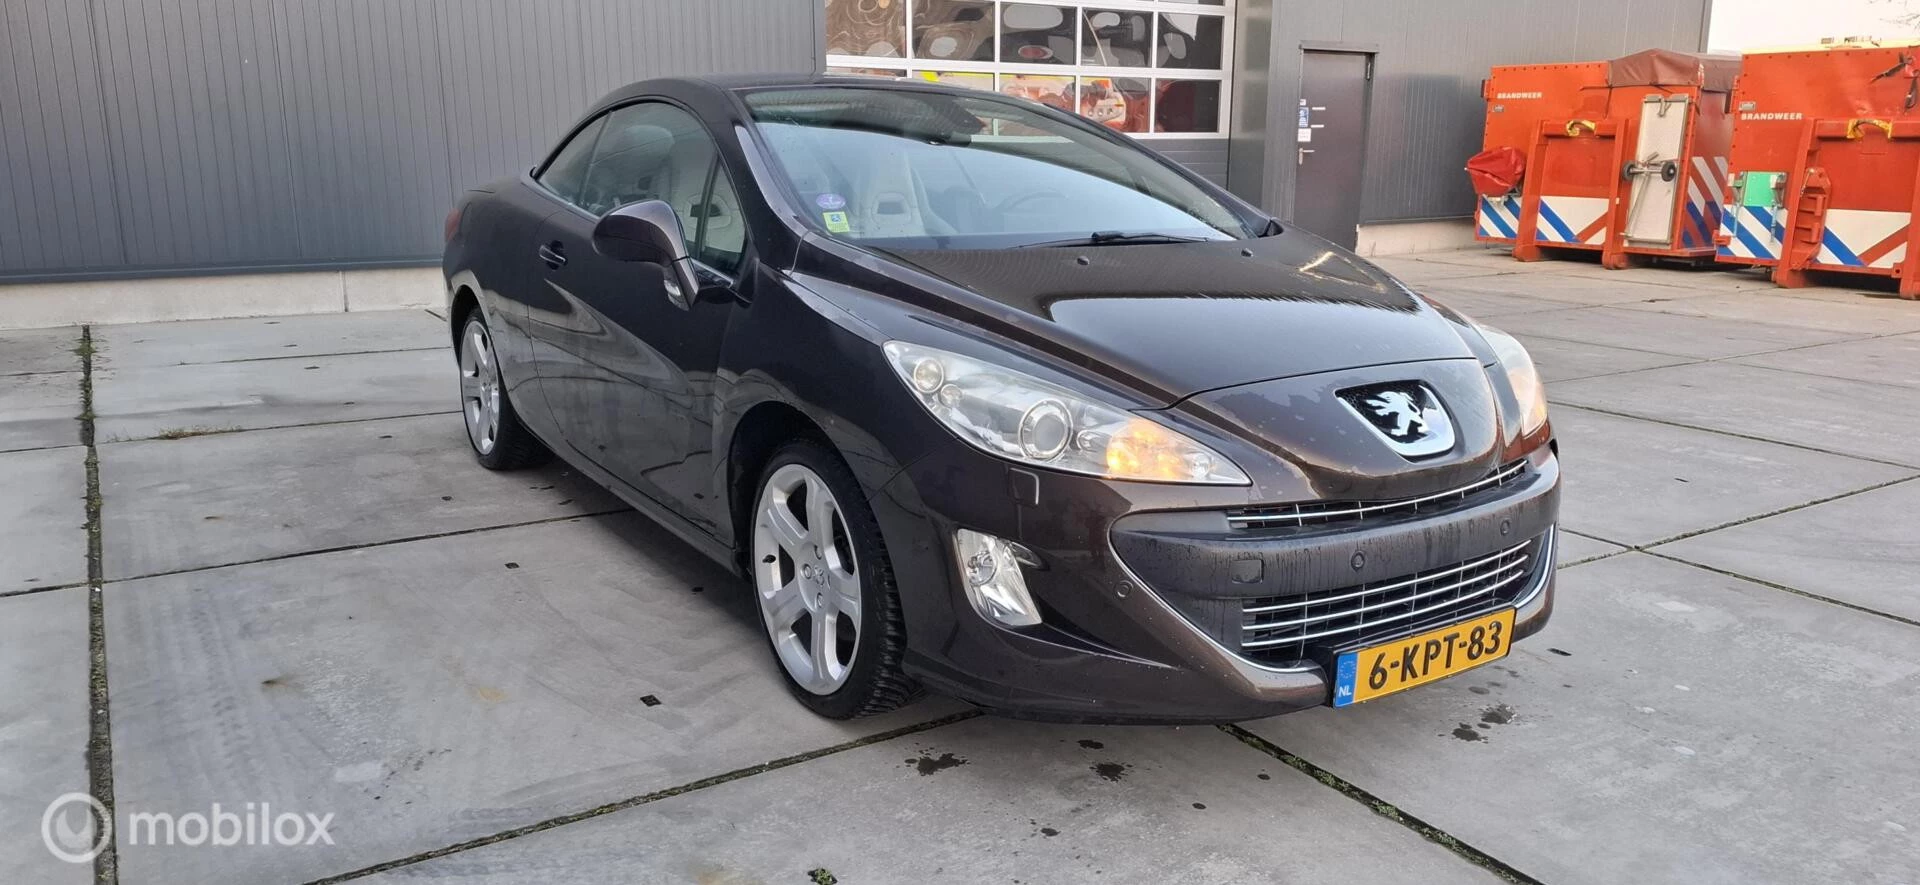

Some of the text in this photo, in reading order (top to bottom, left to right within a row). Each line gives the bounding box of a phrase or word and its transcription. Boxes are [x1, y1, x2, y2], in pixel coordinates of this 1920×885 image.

[1741, 112, 1803, 120] BRANDWEER
[1369, 621, 1502, 690] 6-KPT-83
[1338, 685, 1352, 697] NL
